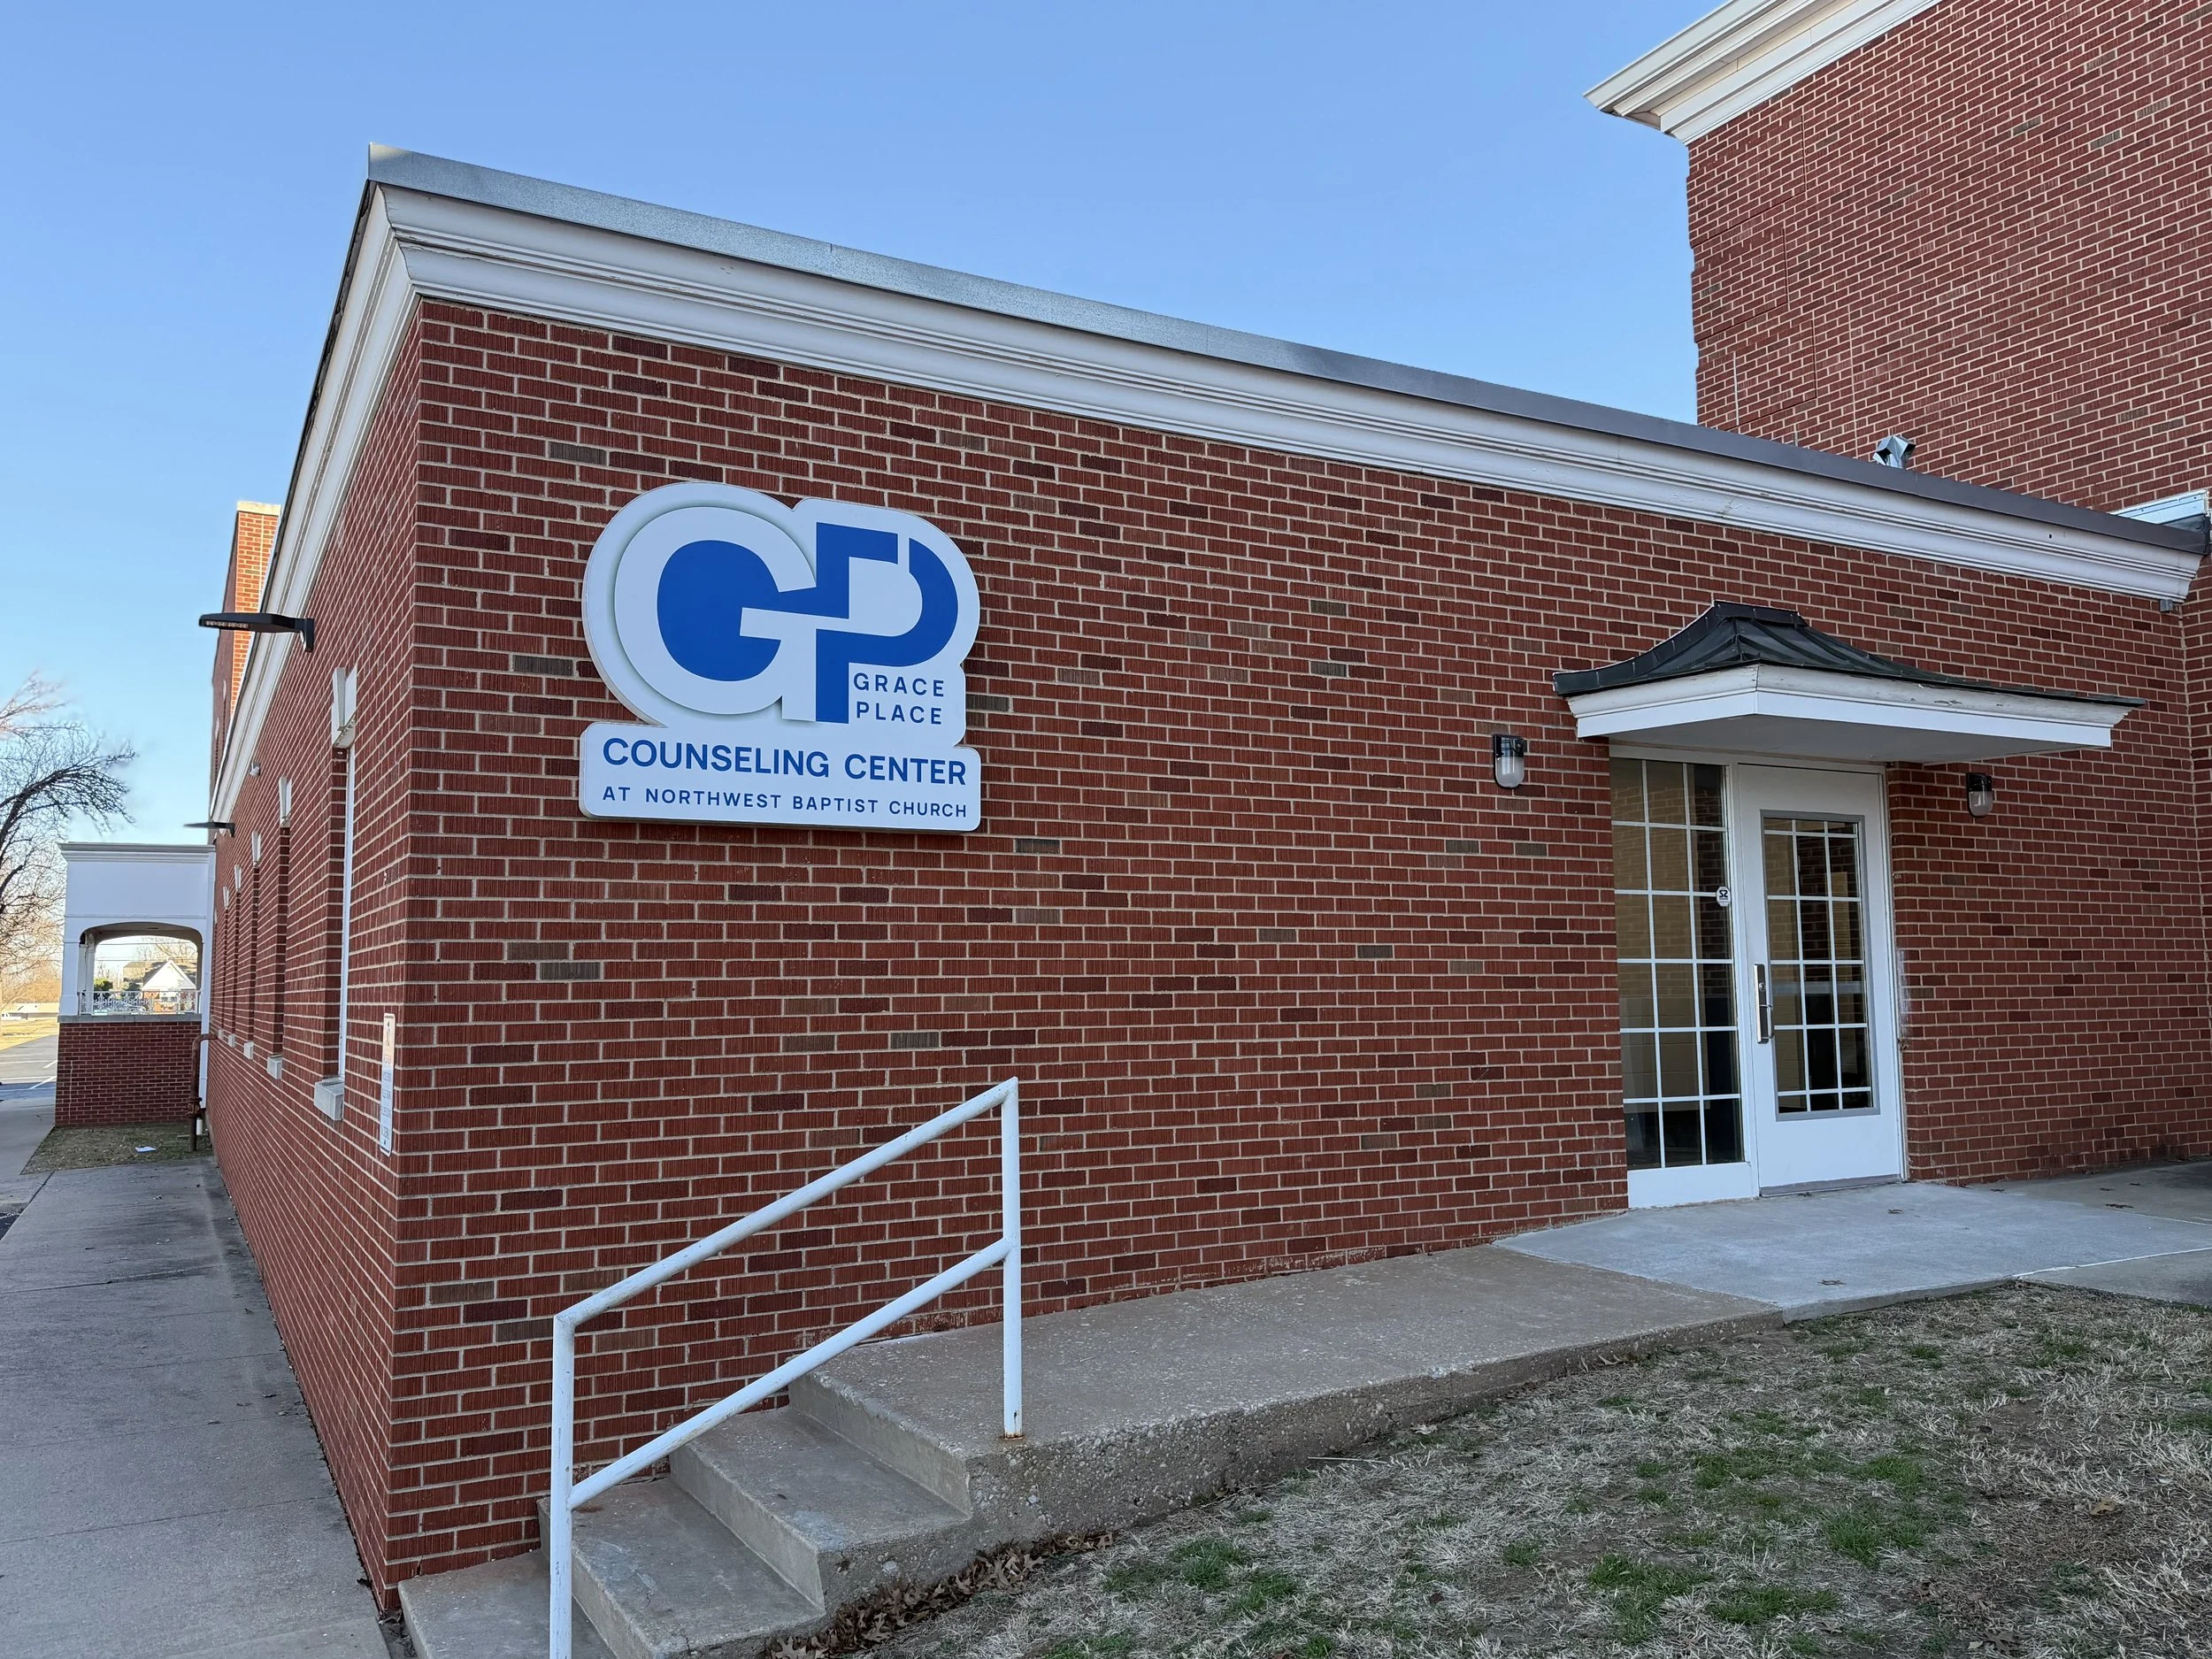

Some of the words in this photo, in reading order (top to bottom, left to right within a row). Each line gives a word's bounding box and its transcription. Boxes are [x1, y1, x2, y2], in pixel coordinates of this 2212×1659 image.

[614, 506, 958, 724] GP
[853, 672, 944, 697] GRACE
[856, 701, 942, 725] PLACE
[603, 737, 829, 778] COUNSELING
[844, 754, 966, 786] CENTER
[603, 786, 631, 802] AT
[645, 787, 781, 809] NORTHWEST
[793, 795, 879, 813] BAPTIST
[888, 801, 966, 818] CHURCH
